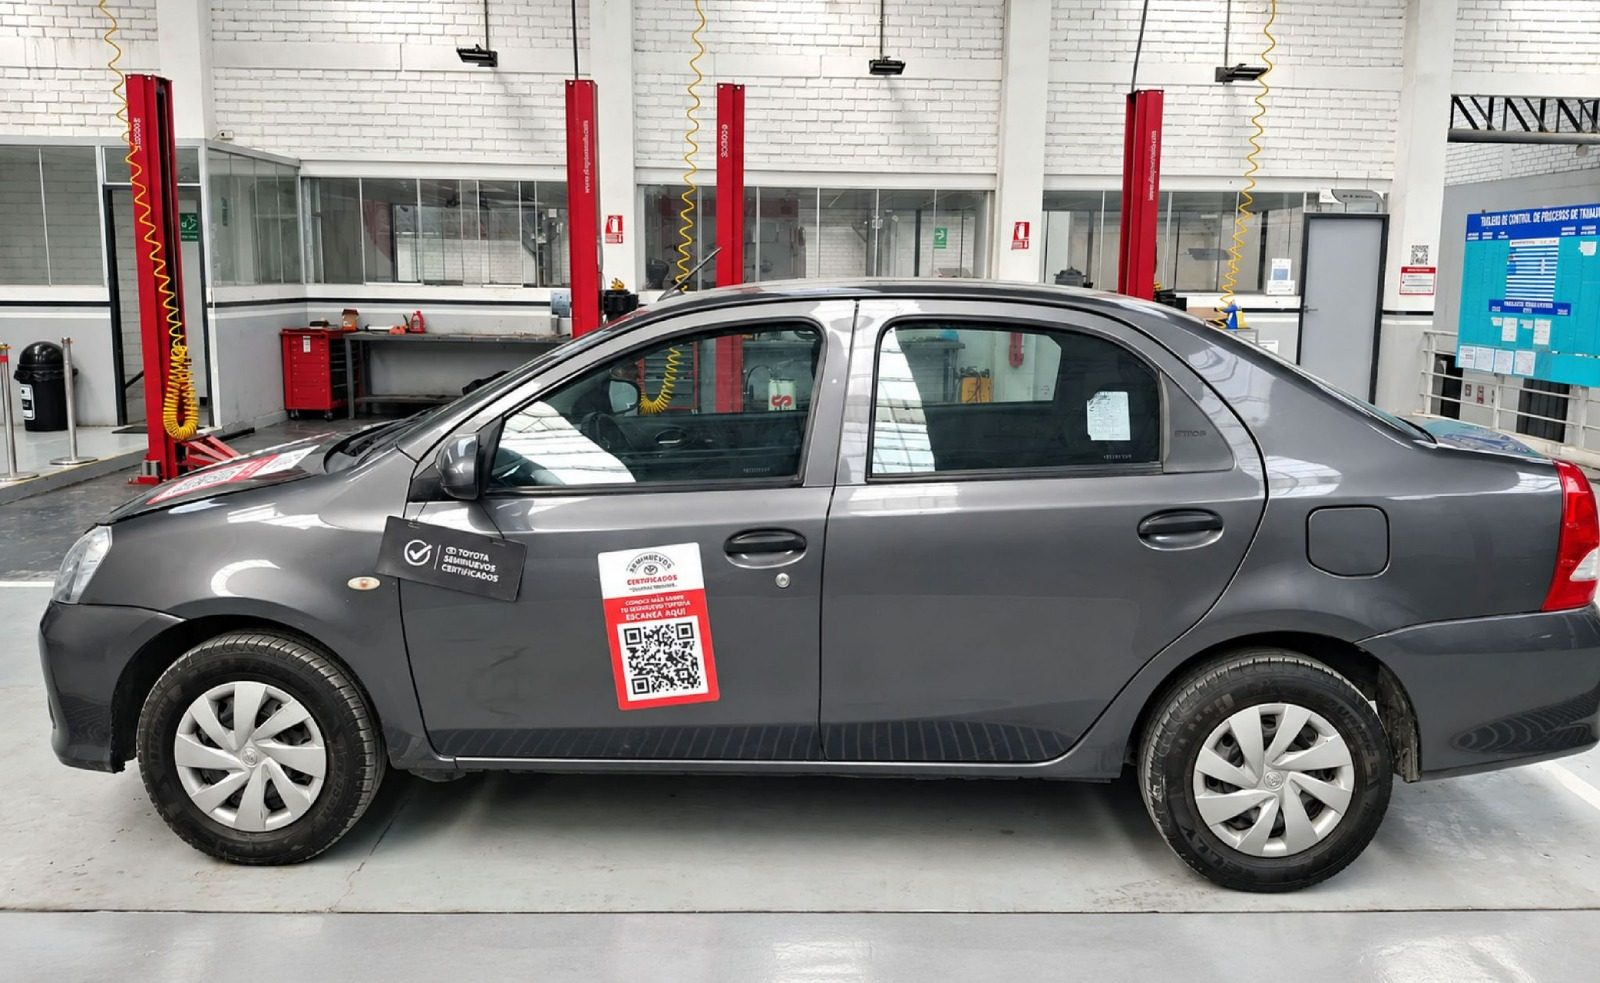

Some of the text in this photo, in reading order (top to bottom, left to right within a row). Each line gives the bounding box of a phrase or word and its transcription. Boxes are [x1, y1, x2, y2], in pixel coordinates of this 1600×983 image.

[458, 549, 489, 562] TOYOTA
[443, 555, 496, 572] SEMINUEVOS
[442, 564, 499, 582] CERTIFICADOS
[627, 575, 677, 585] CERTIFICADOS
[626, 611, 662, 620] ESCANEA
